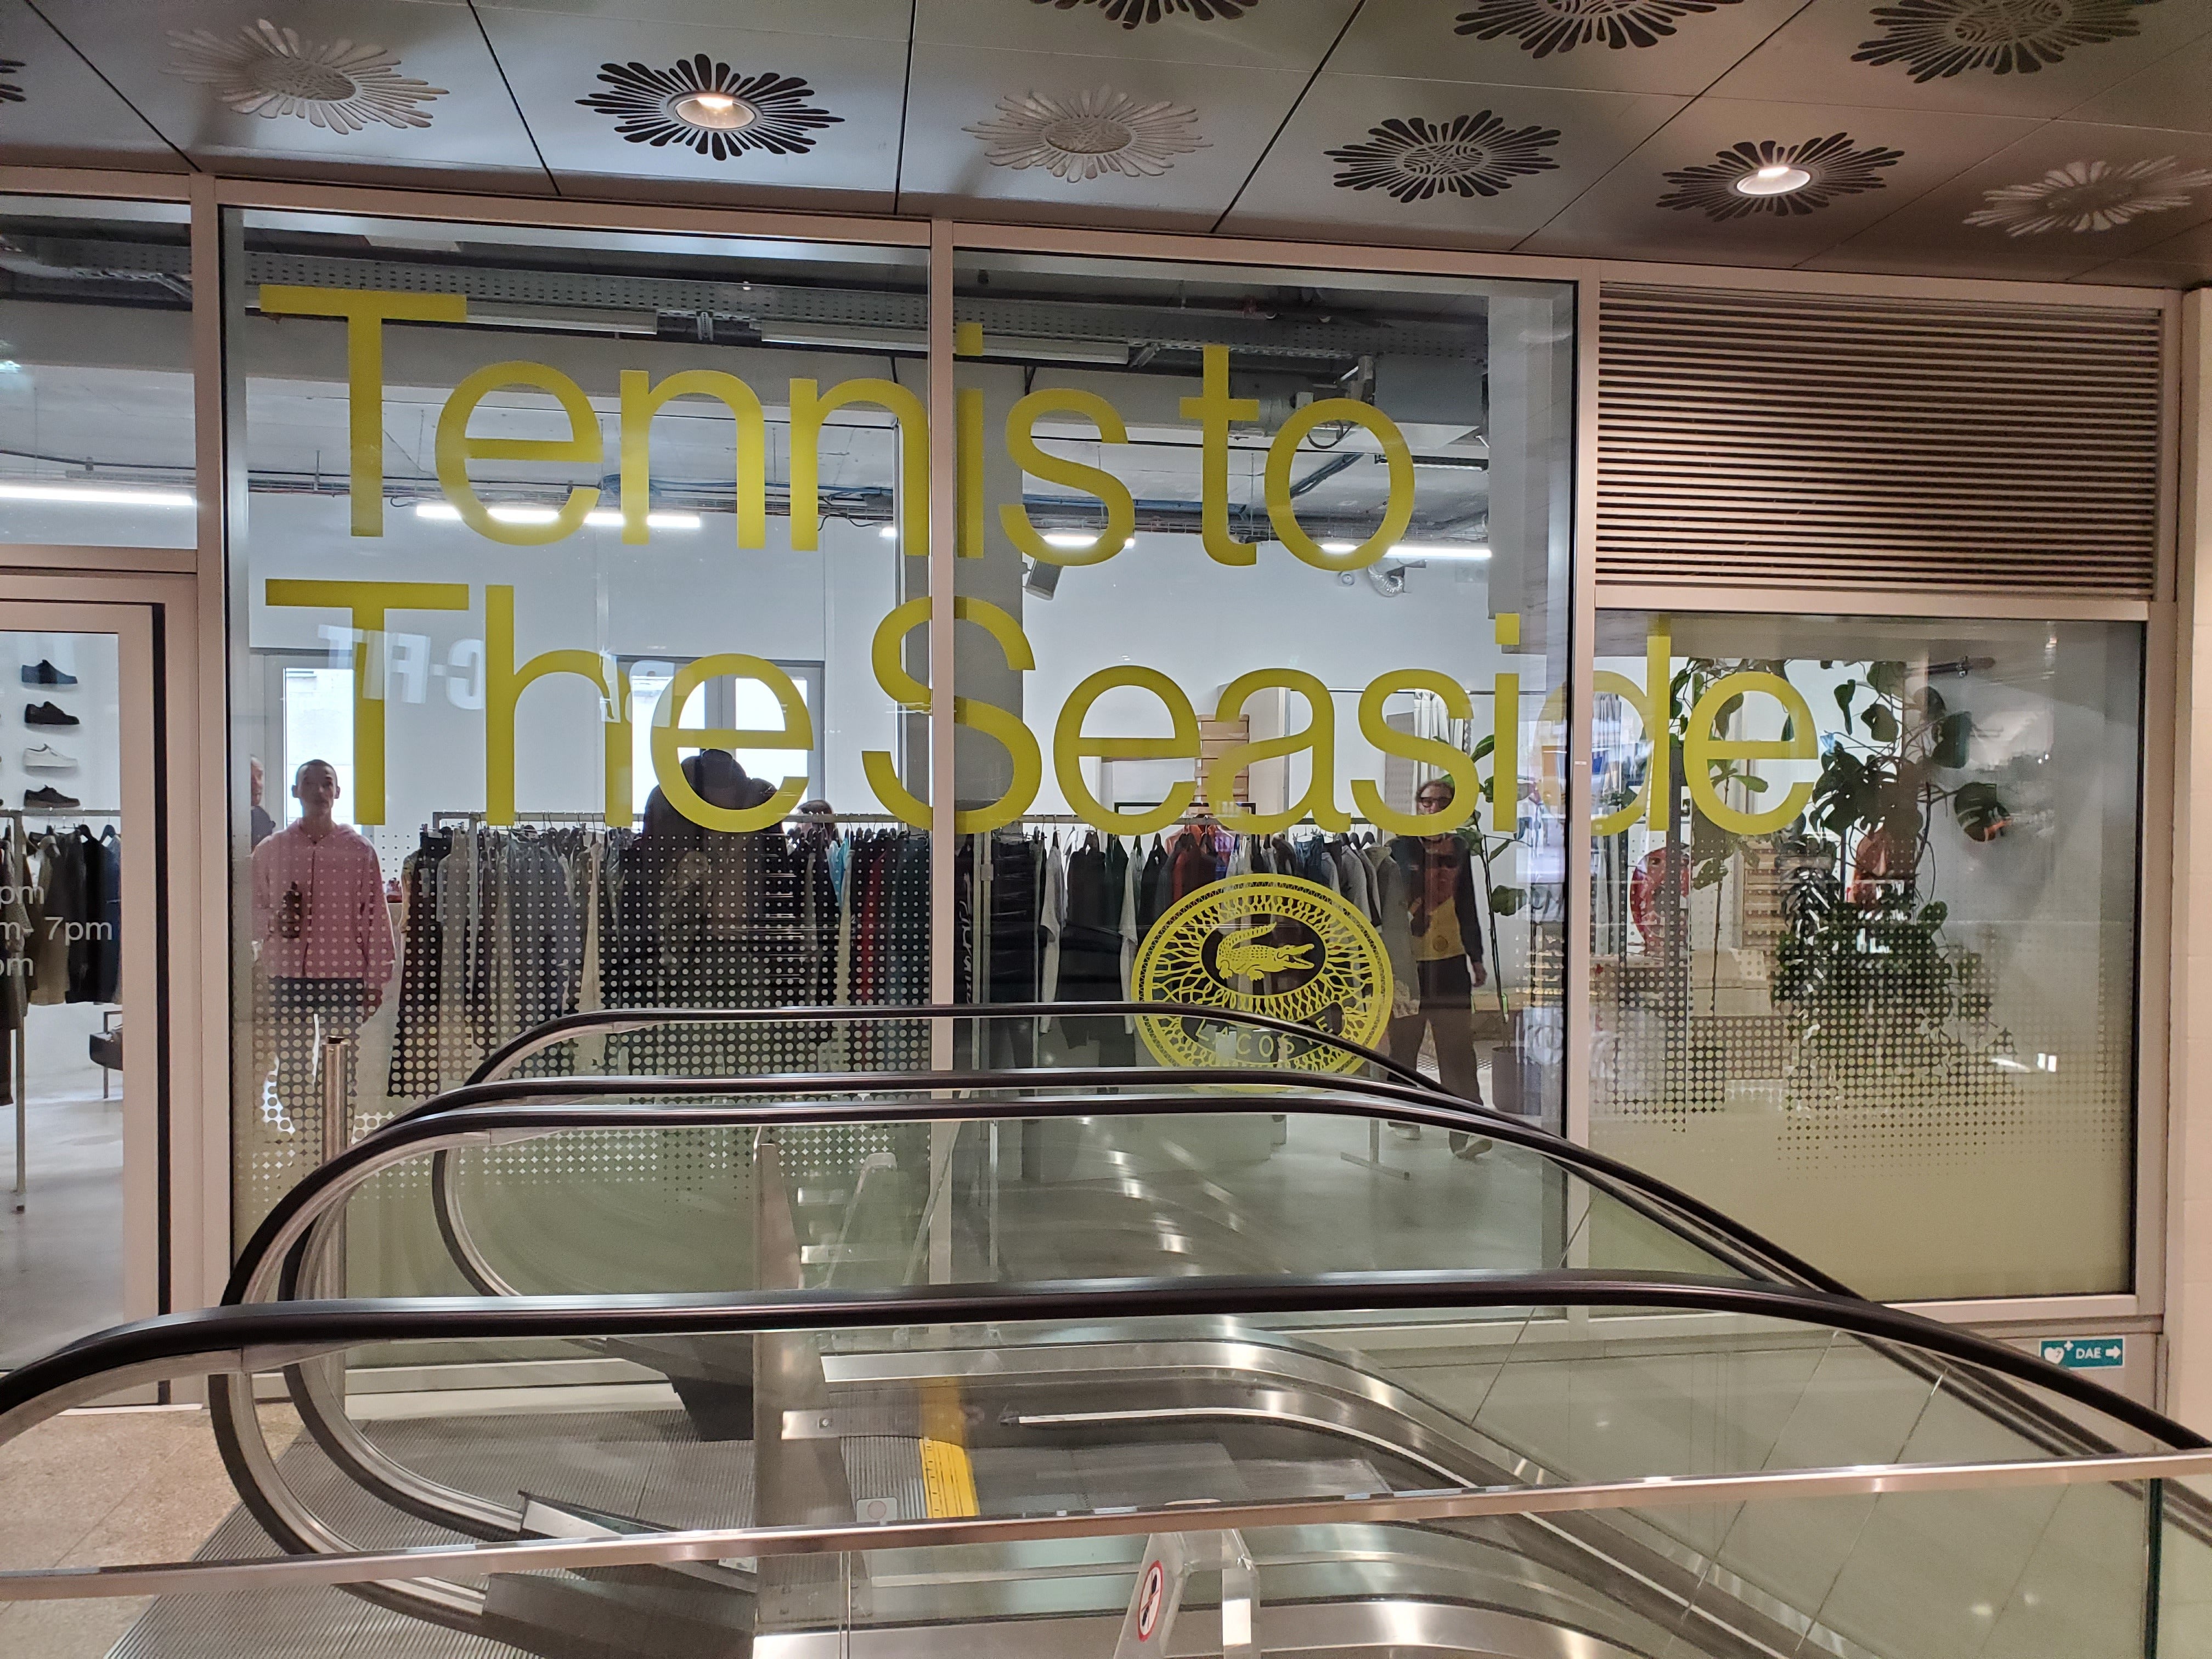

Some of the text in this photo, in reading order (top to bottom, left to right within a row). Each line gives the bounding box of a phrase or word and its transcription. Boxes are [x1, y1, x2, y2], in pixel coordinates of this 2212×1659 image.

[259, 284, 1415, 571] Tennis to
[266, 578, 1819, 836] The Seaside
[44, 916, 112, 946] 7pm
[2075, 1347, 2102, 1359] DAE
